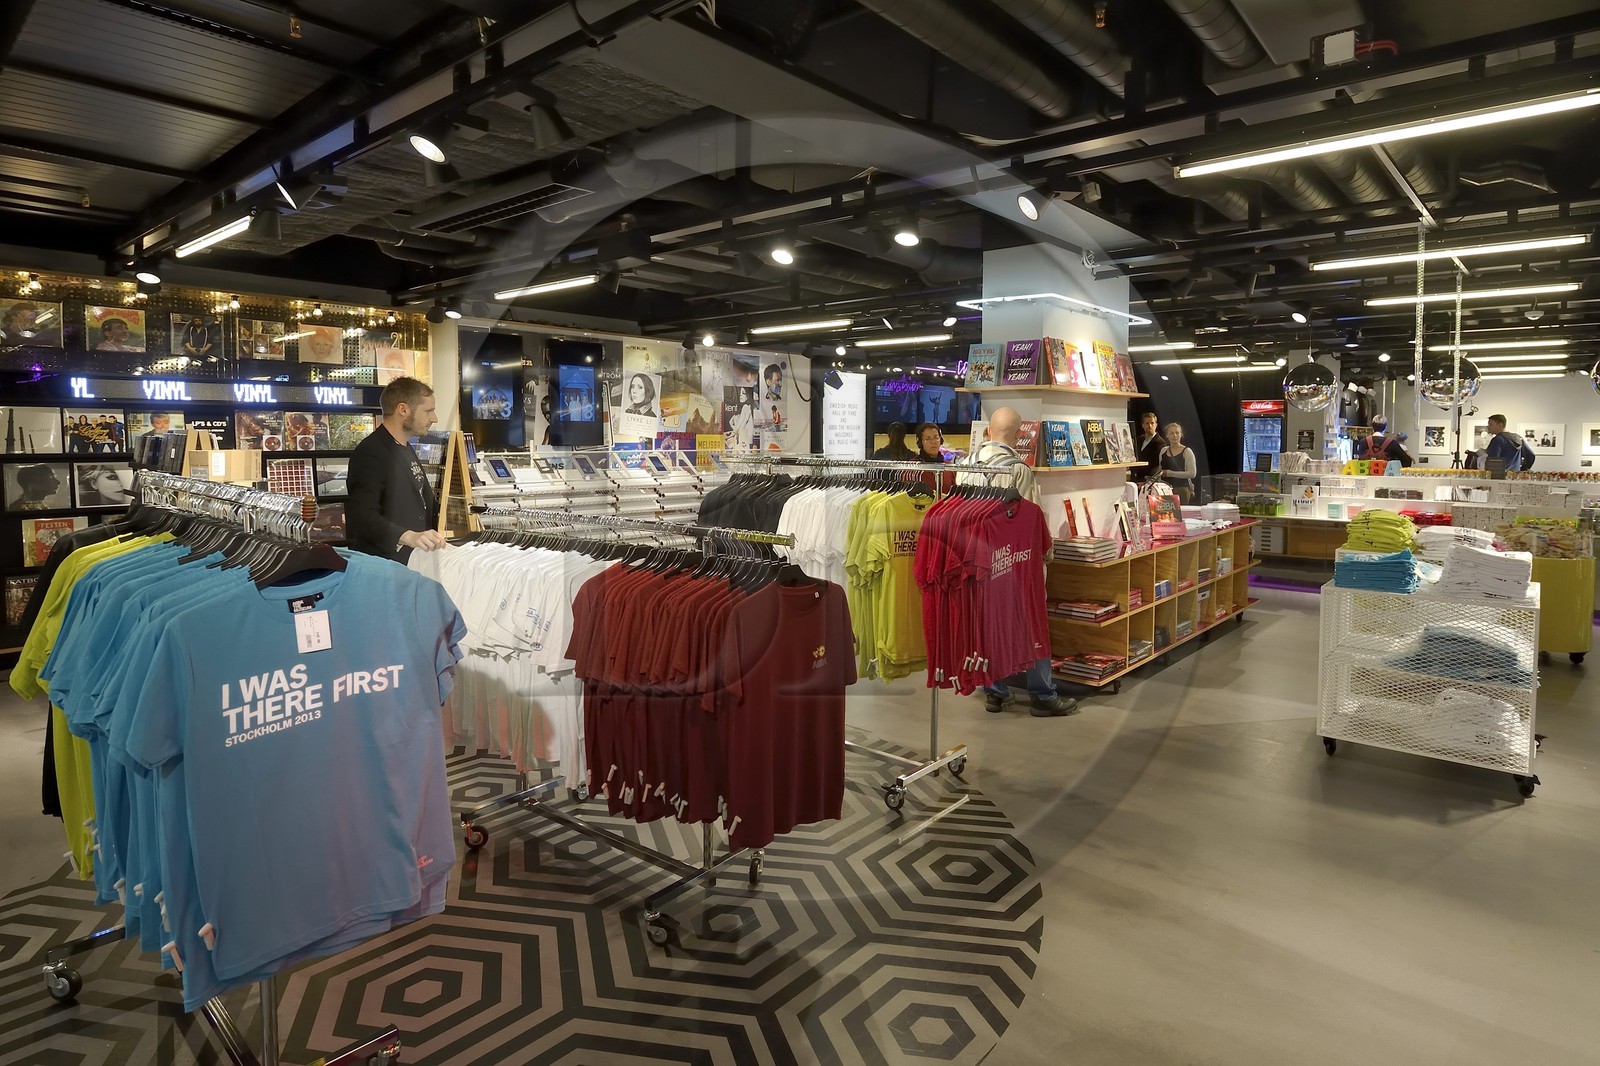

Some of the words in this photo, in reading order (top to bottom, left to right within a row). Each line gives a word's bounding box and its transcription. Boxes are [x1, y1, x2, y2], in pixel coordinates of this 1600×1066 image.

[1011, 343, 1033, 352] YEAH!
[1009, 358, 1031, 367] YEAH!
[1007, 373, 1029, 381] YEAH!
[70, 377, 95, 398] YL
[143, 380, 192, 400] VINYL
[233, 384, 277, 403] VINYL
[314, 387, 353, 405] VINYL
[725, 404, 738, 412] kent
[1051, 424, 1065, 432] YEAH!
[1087, 423, 1102, 432] ABBA
[1052, 439, 1066, 447] YEAH!
[1053, 453, 1068, 462] YEAH!
[40, 521, 68, 529] FESTEN
[894, 531, 897, 541] I
[898, 530, 917, 541] WAS
[893, 541, 918, 552] THERE
[991, 552, 995, 563] I
[995, 543, 1011, 560] WAS
[991, 554, 1012, 574] THERE
[1012, 549, 1031, 564] FIRST
[222, 684, 230, 710] I
[239, 664, 308, 703] WAS
[222, 683, 323, 734] THERE
[333, 665, 404, 703] FIRST
[225, 718, 292, 747] STOCKHOLM
[294, 710, 322, 726] 2013
